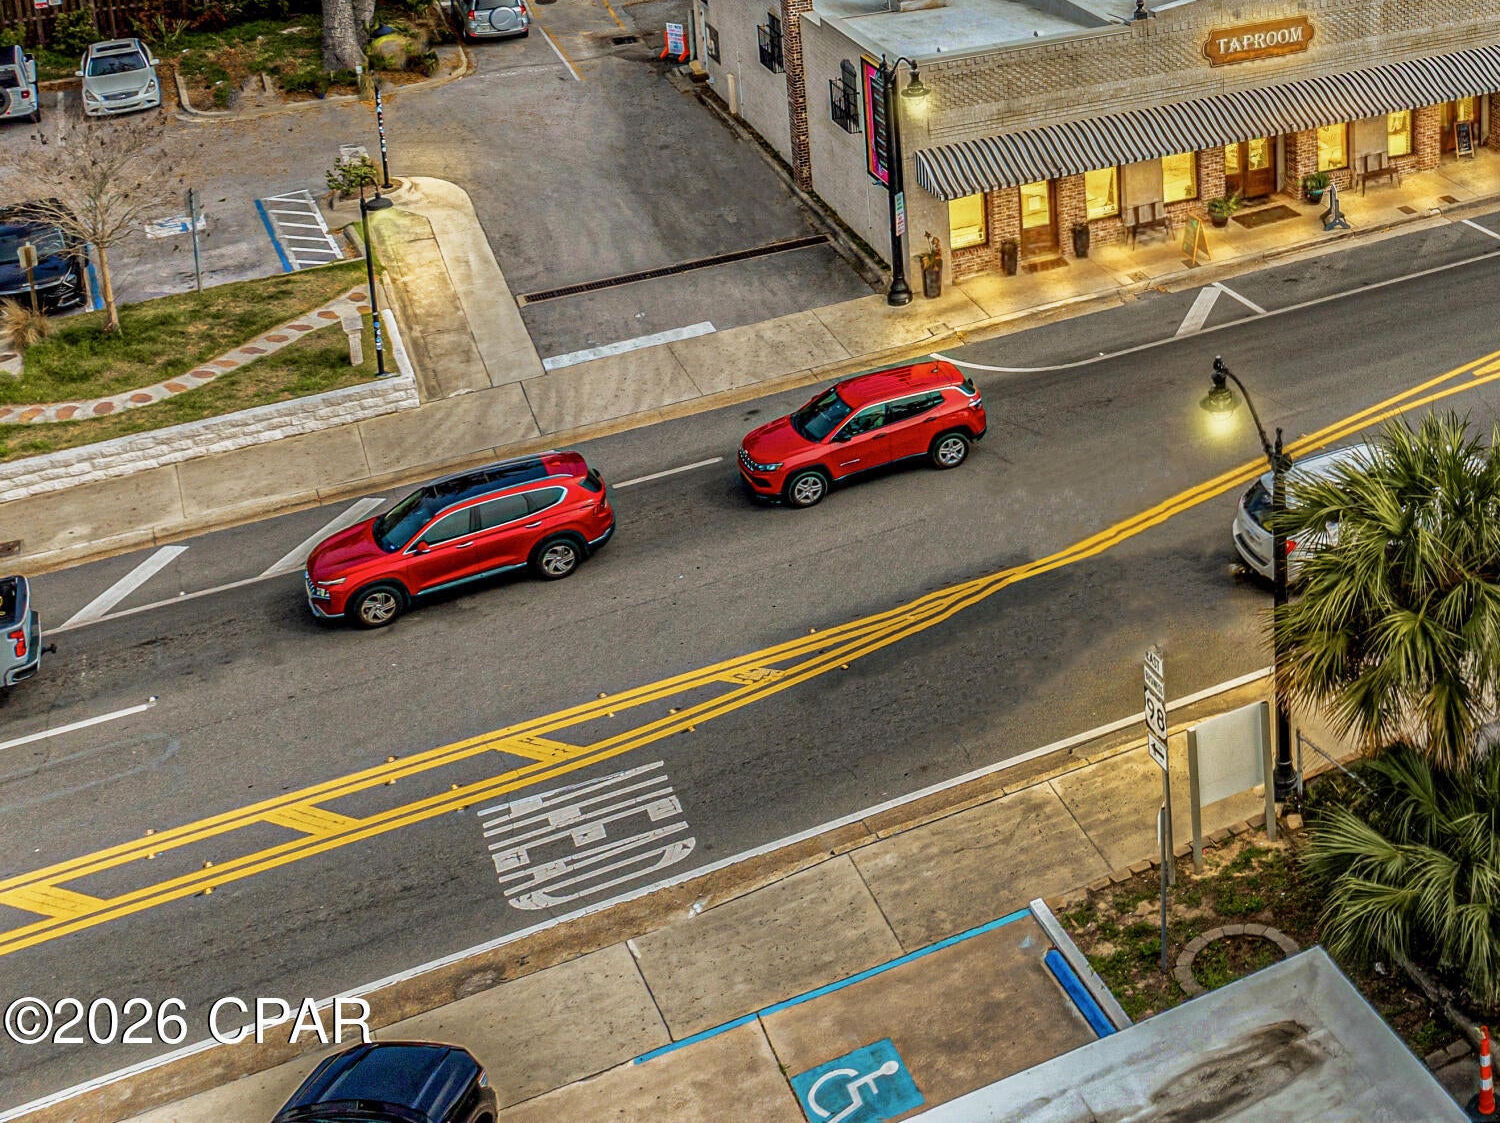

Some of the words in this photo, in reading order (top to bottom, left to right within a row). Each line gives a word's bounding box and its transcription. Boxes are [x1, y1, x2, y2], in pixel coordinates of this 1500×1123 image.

[1215, 26, 1304, 55] TAPROOM
[1146, 651, 1160, 673] EAST
[1146, 696, 1166, 733] 98
